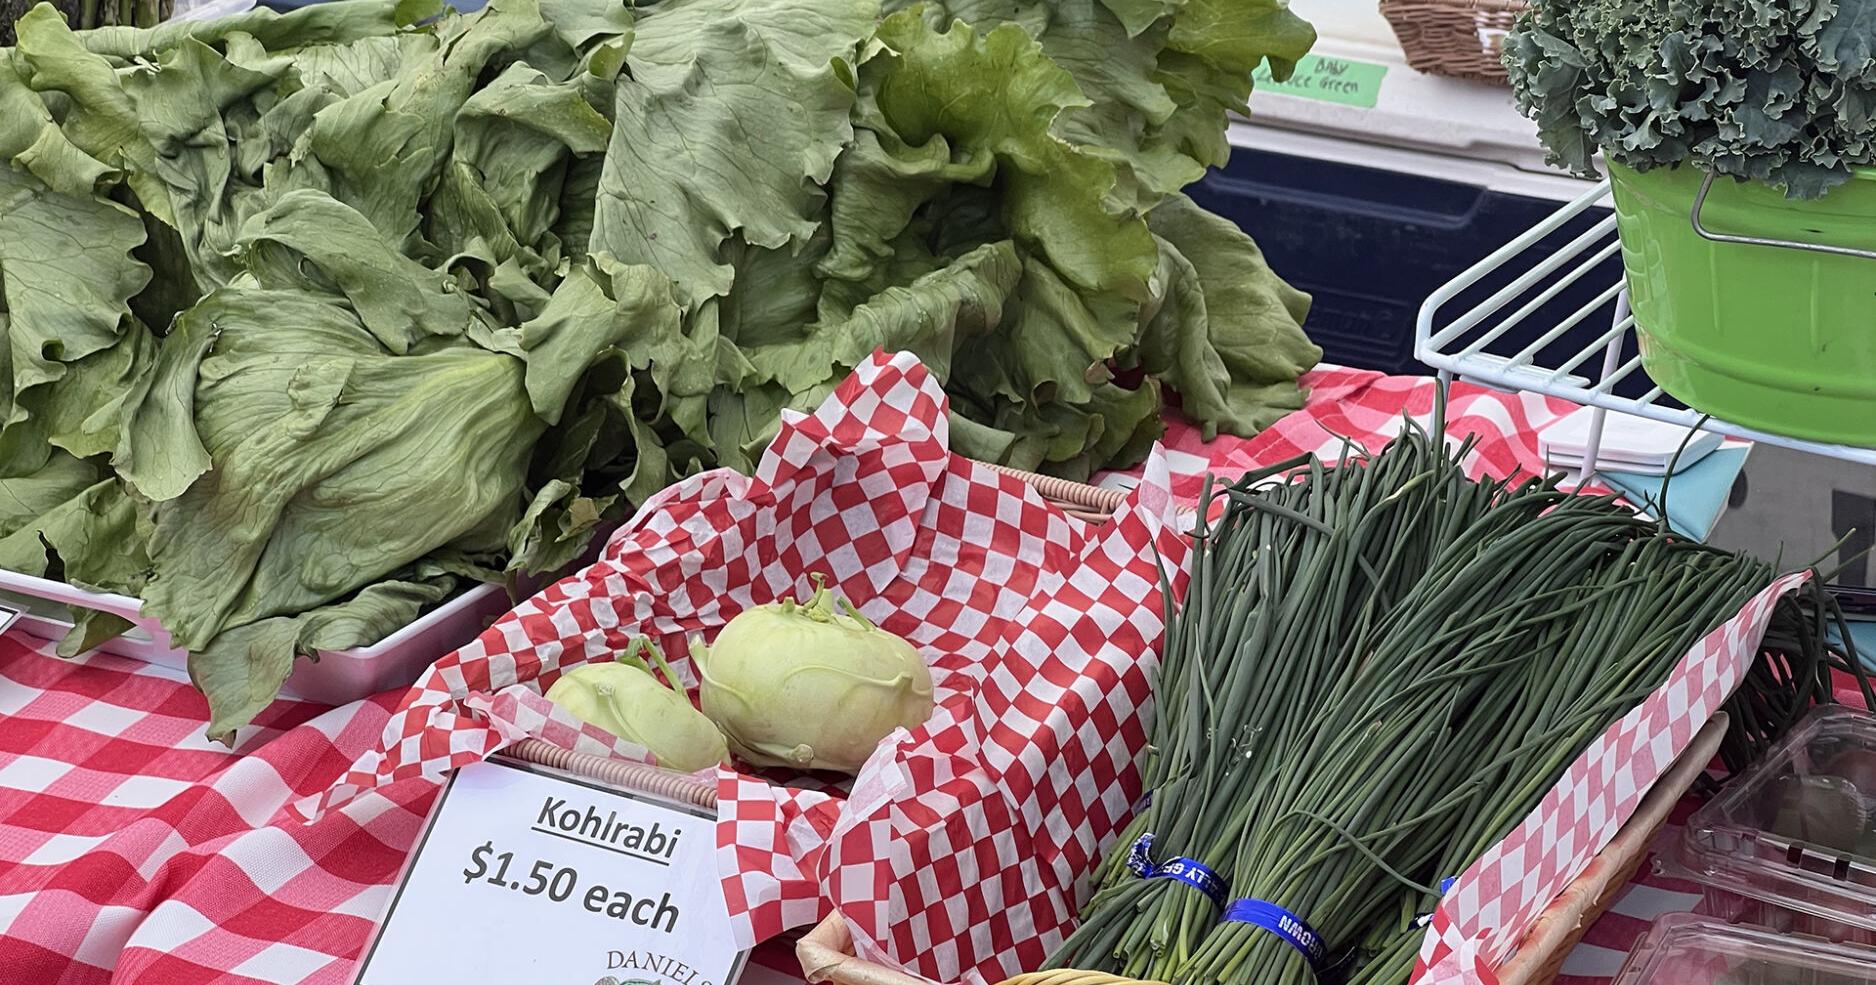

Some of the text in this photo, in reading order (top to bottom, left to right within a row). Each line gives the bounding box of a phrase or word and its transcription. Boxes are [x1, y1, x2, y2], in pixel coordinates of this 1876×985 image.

[537, 796, 682, 859] Kohlrabi
[462, 840, 681, 934] $1.50 each
[606, 950, 712, 985] DANIEL
